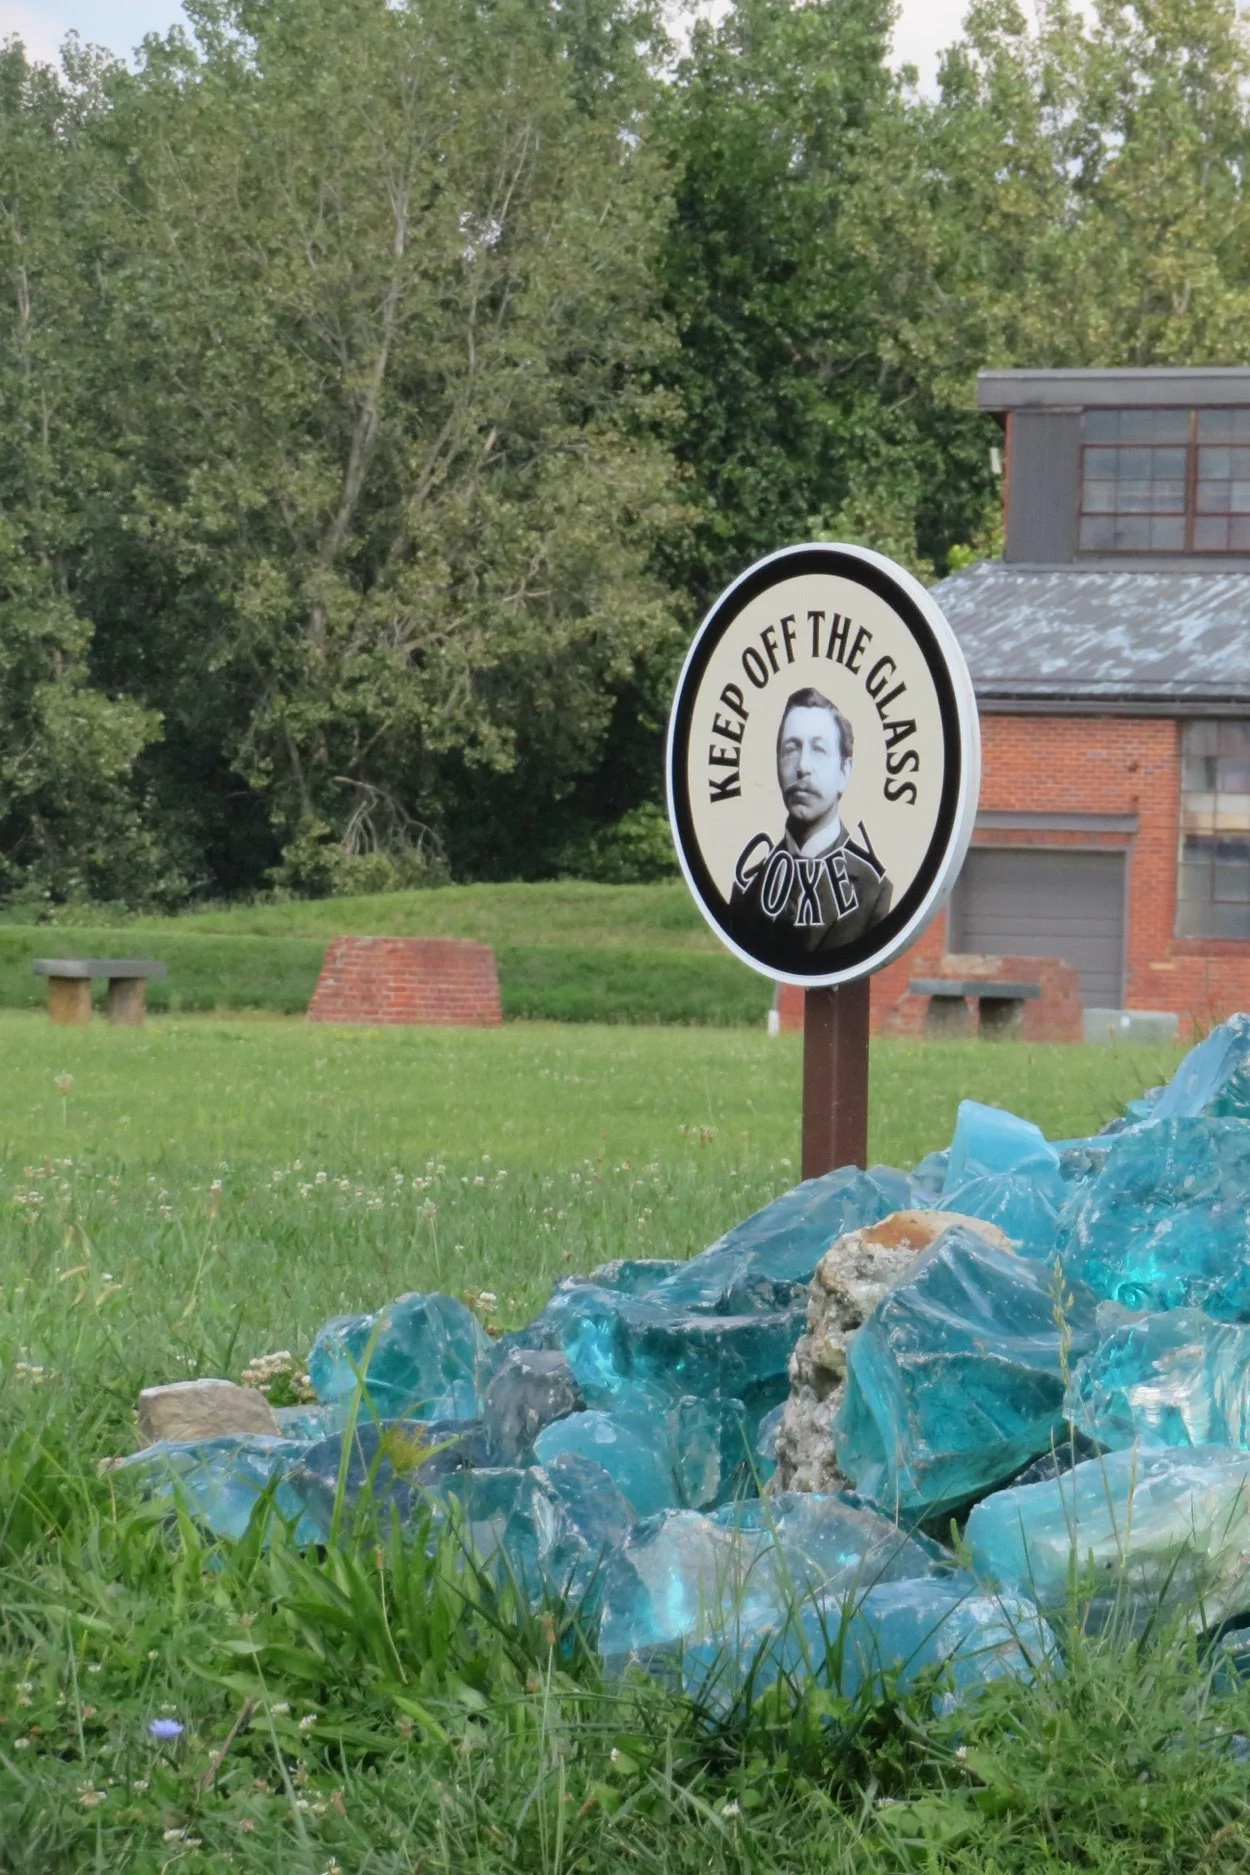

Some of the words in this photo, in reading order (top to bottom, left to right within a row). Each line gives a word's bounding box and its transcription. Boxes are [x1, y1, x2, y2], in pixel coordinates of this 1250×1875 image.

[708, 682, 749, 804] KEEP
[741, 613, 797, 689] OFF
[806, 610, 873, 675] THE
[865, 655, 920, 806] GLASS
[734, 819, 888, 927] COXEY
